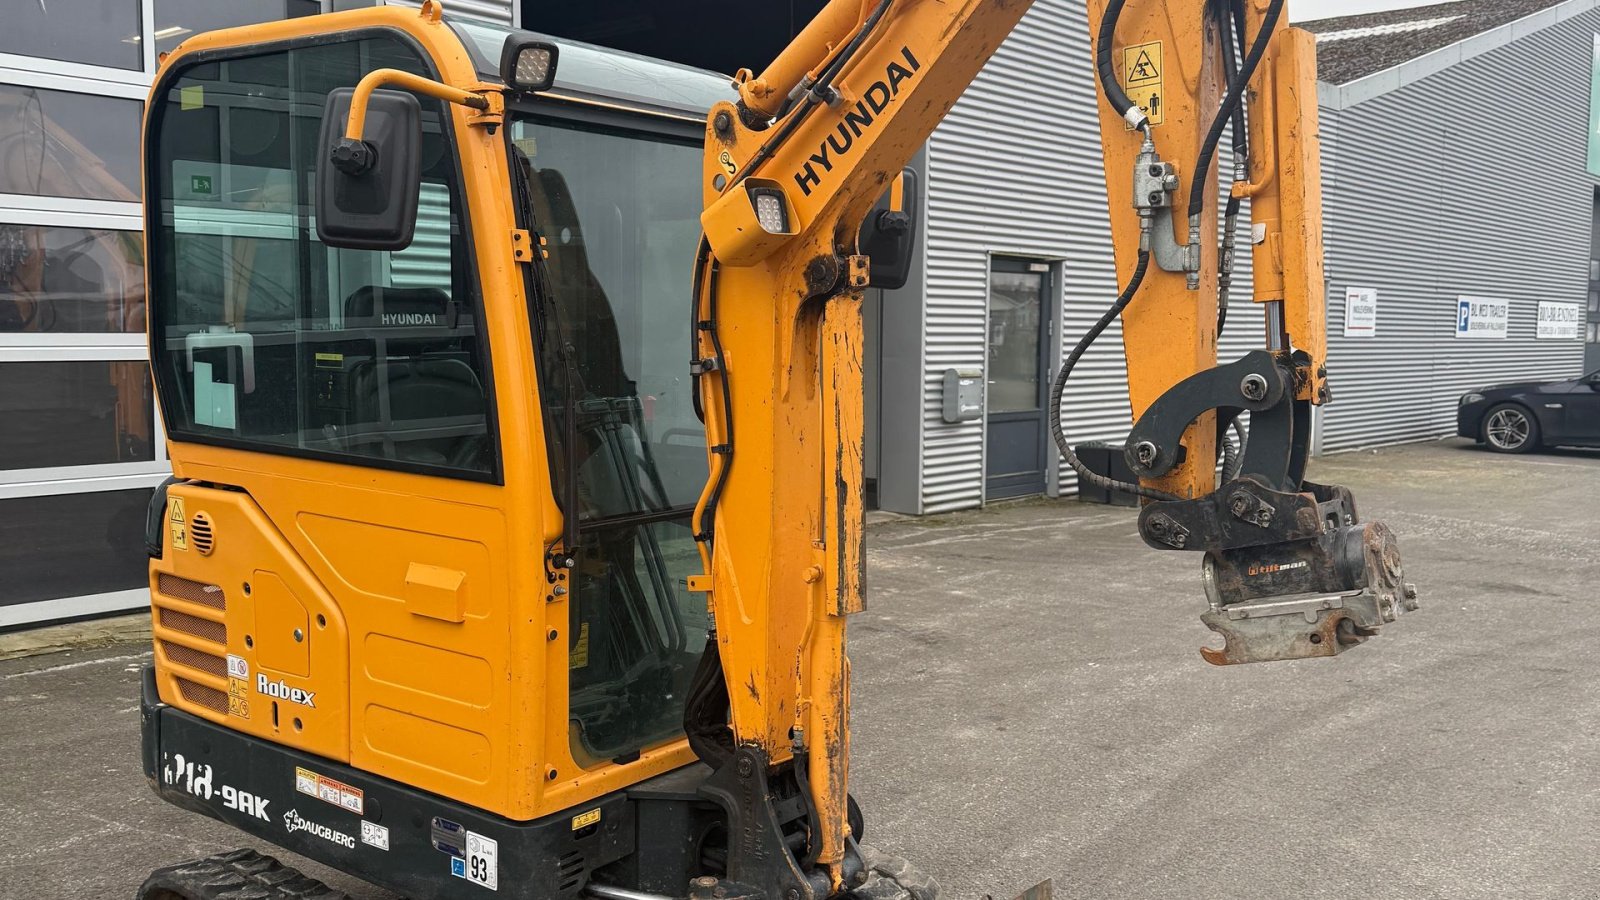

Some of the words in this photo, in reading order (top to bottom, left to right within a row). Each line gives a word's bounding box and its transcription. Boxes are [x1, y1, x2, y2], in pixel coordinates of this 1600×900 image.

[794, 46, 921, 196] HYUNDAI
[381, 313, 436, 325] HYUNDAI
[1260, 561, 1307, 573] tiltman
[257, 672, 316, 708] Robex
[298, 817, 356, 849] DAUGBJERG
[471, 854, 487, 882] 93
